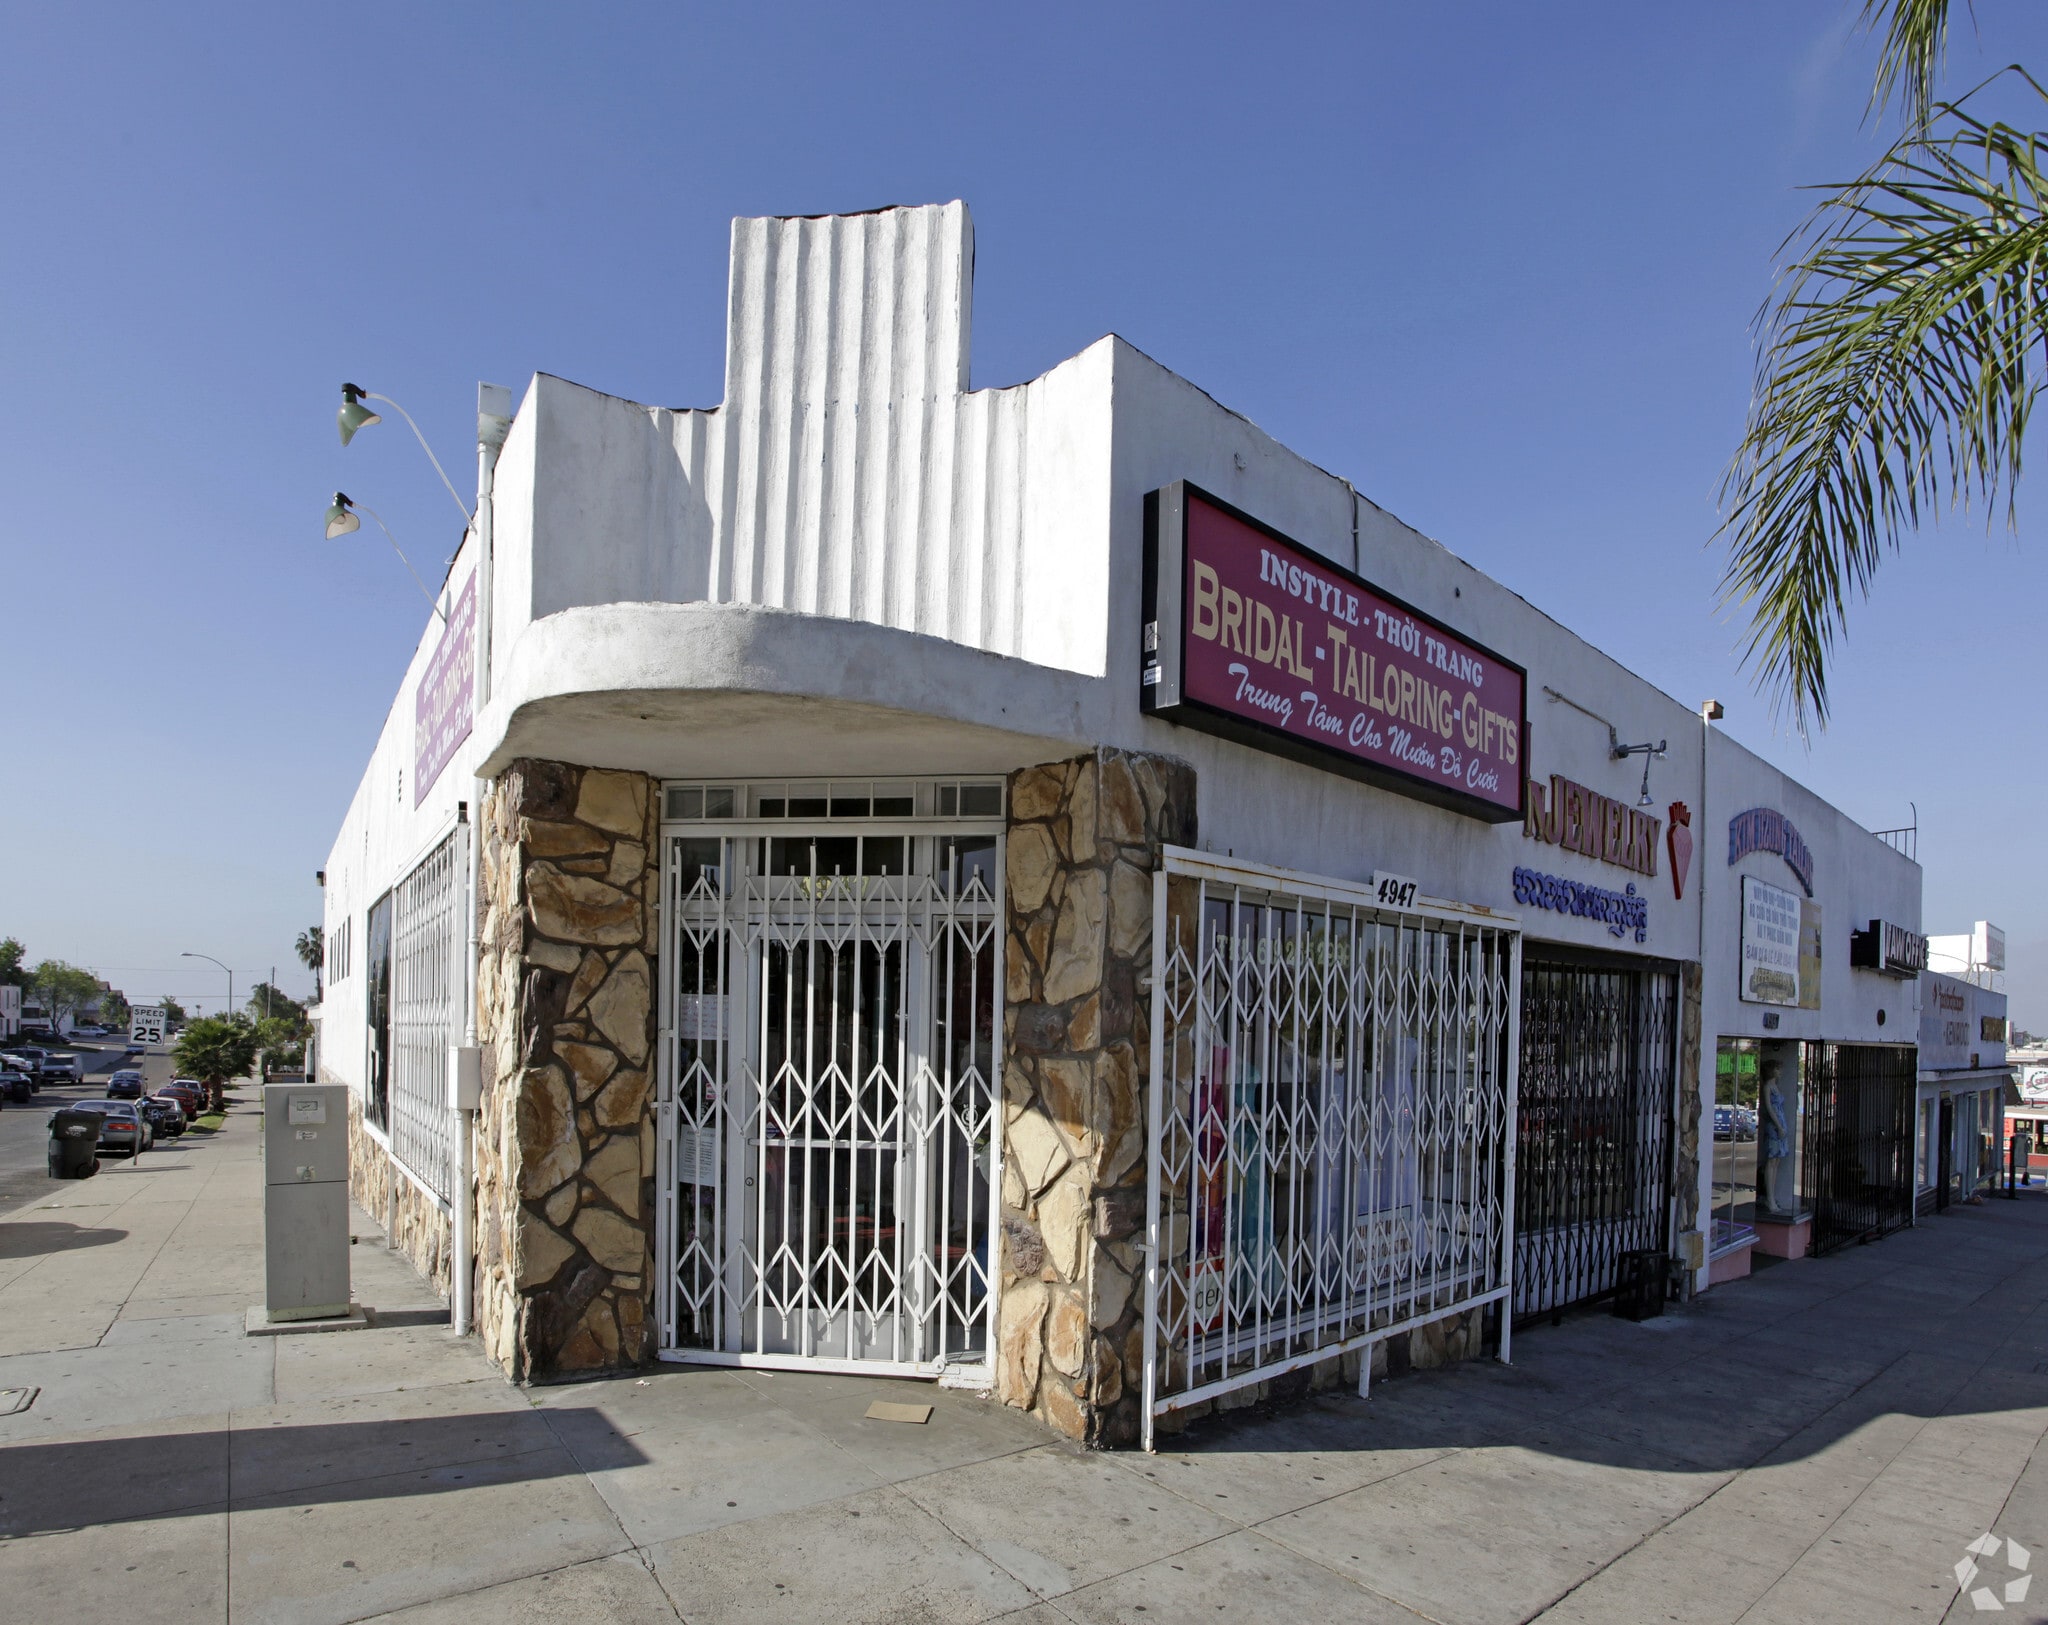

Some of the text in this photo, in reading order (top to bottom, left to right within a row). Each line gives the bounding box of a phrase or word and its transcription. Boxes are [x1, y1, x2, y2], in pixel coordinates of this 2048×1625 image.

[1259, 548, 1359, 627] INSTYLE
[1374, 608, 1420, 658] THỜI
[1424, 635, 1484, 688] TRANG
[1228, 663, 1293, 727] Trung
[1300, 690, 1344, 736] Tâm
[1348, 712, 1383, 749] Cho
[1545, 773, 1662, 876] JEWELRY
[1378, 878, 1417, 908] 4947
[134, 1008, 164, 1018] SPEED
[136, 1018, 161, 1026] LIMIT
[133, 1027, 161, 1042] 25
